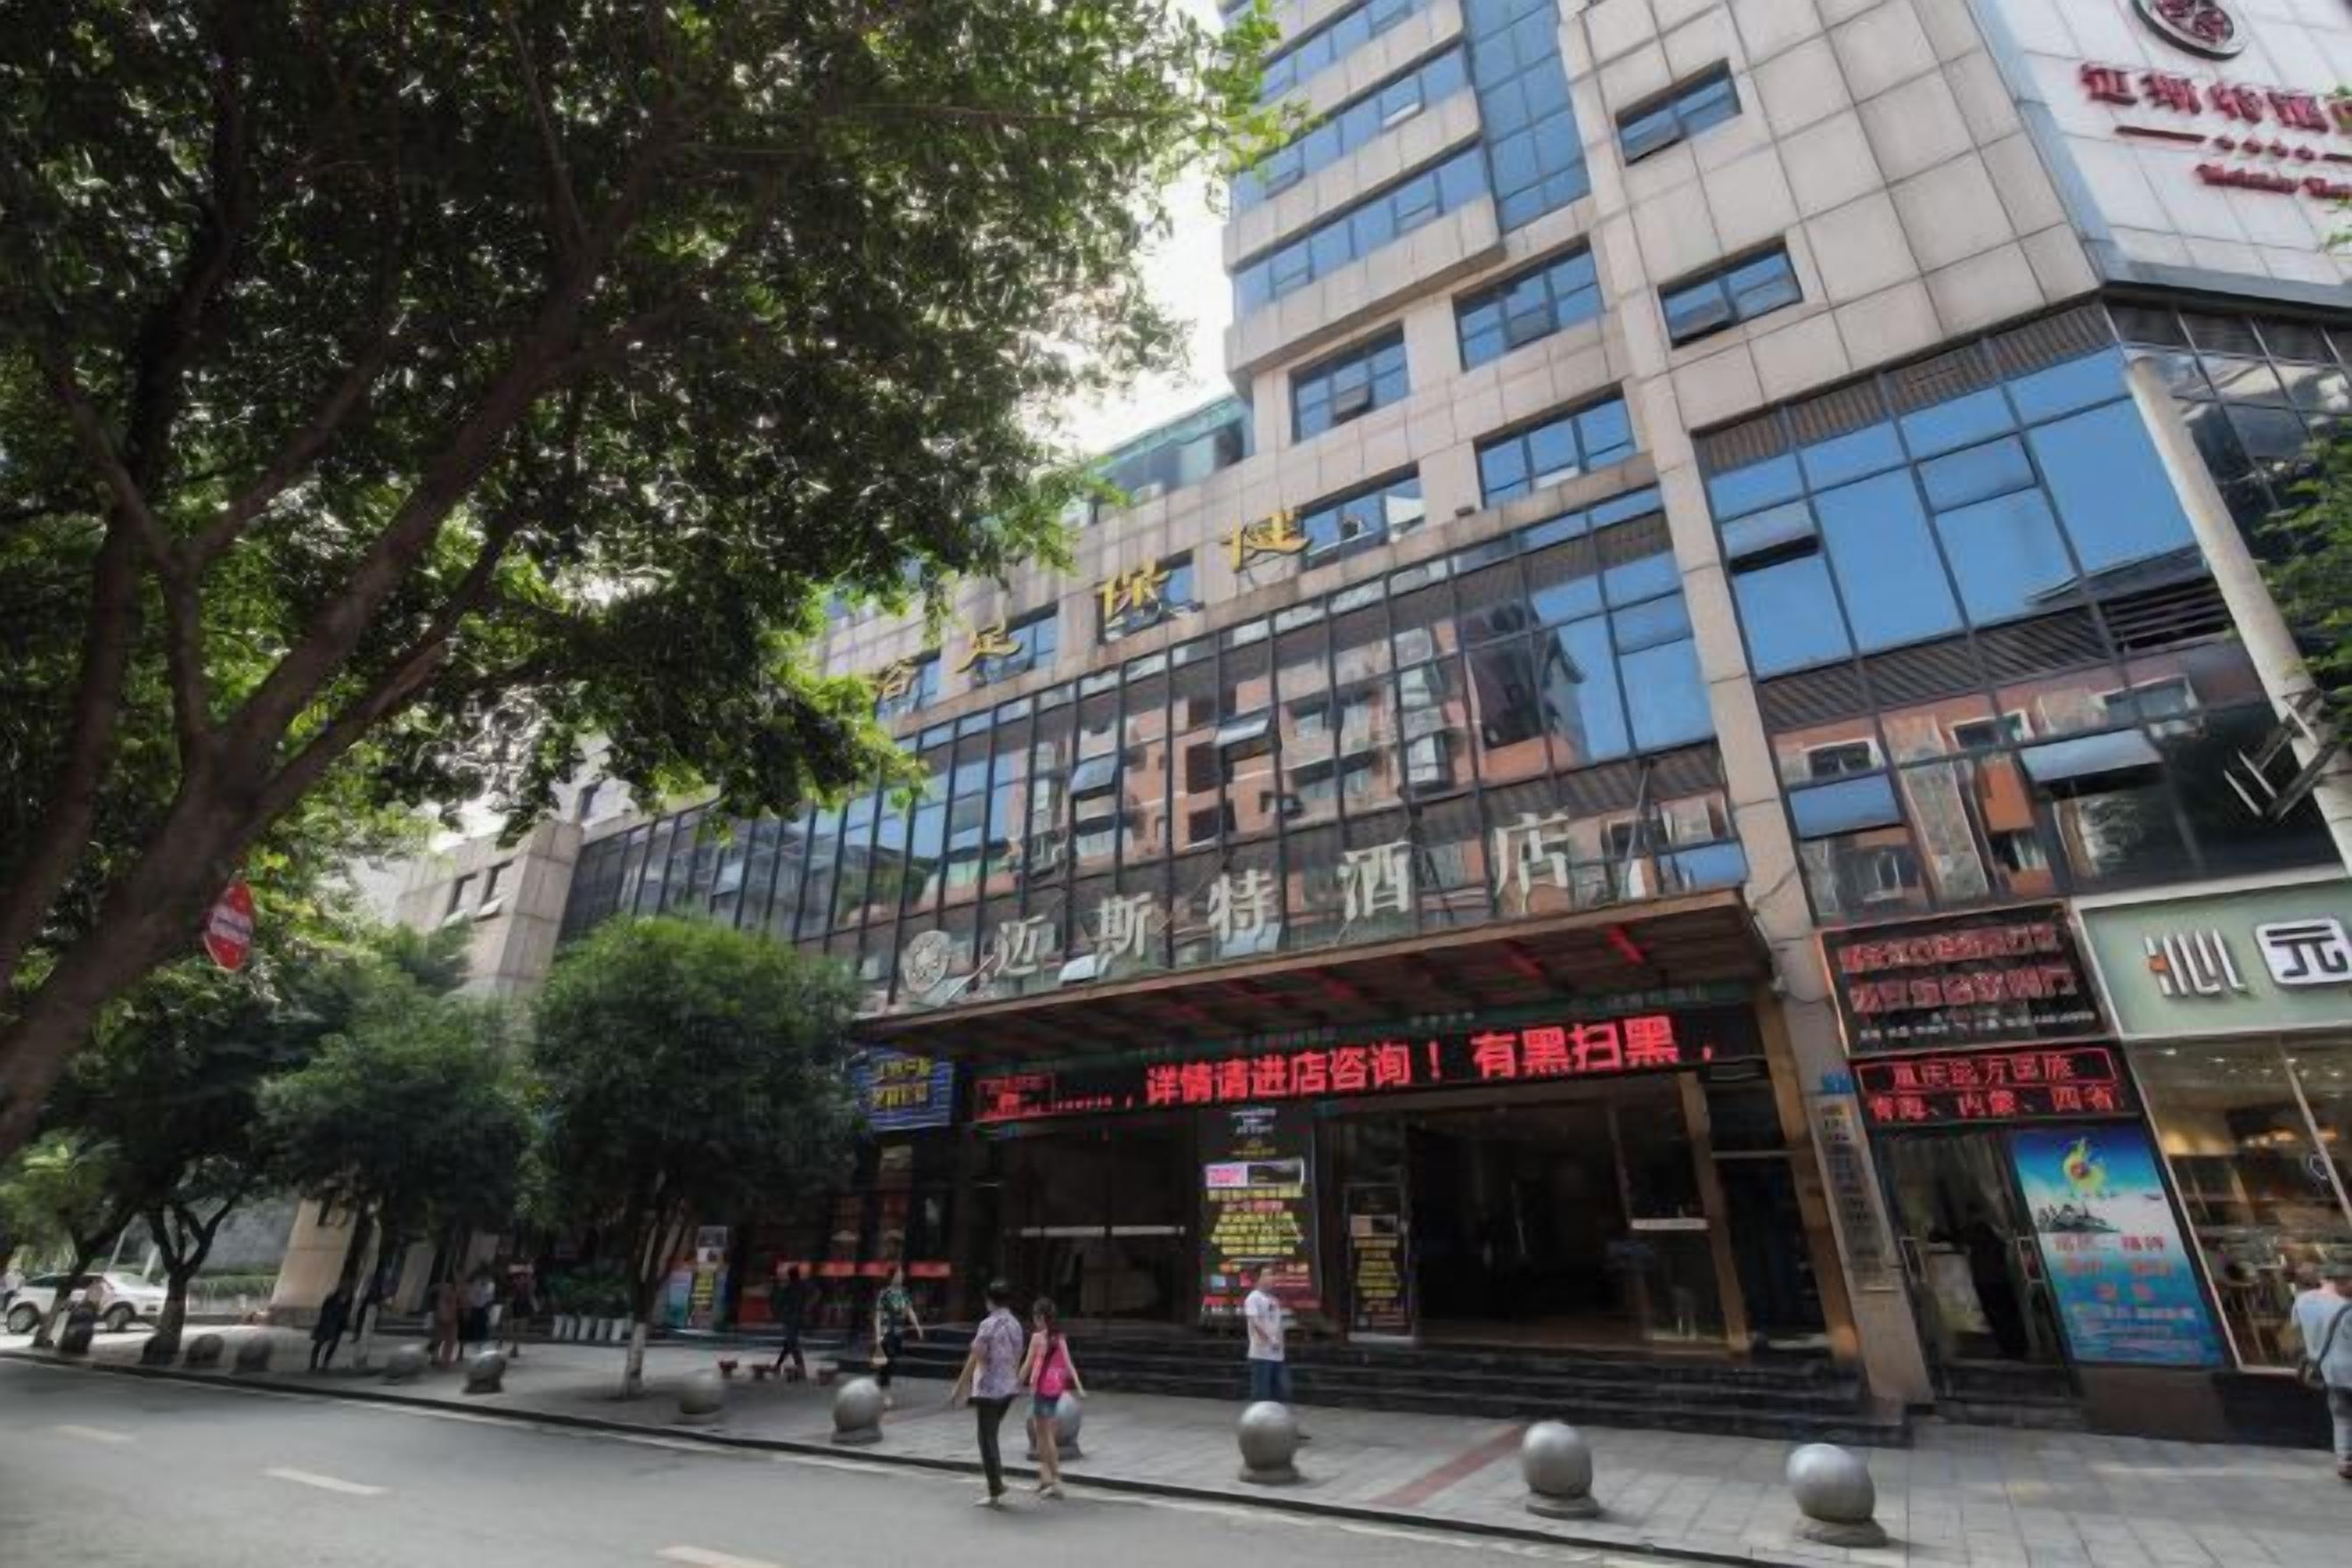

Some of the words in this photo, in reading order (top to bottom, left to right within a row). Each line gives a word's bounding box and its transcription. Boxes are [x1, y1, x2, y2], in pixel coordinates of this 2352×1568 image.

[991, 811, 1572, 978] 迈斯特酒店
